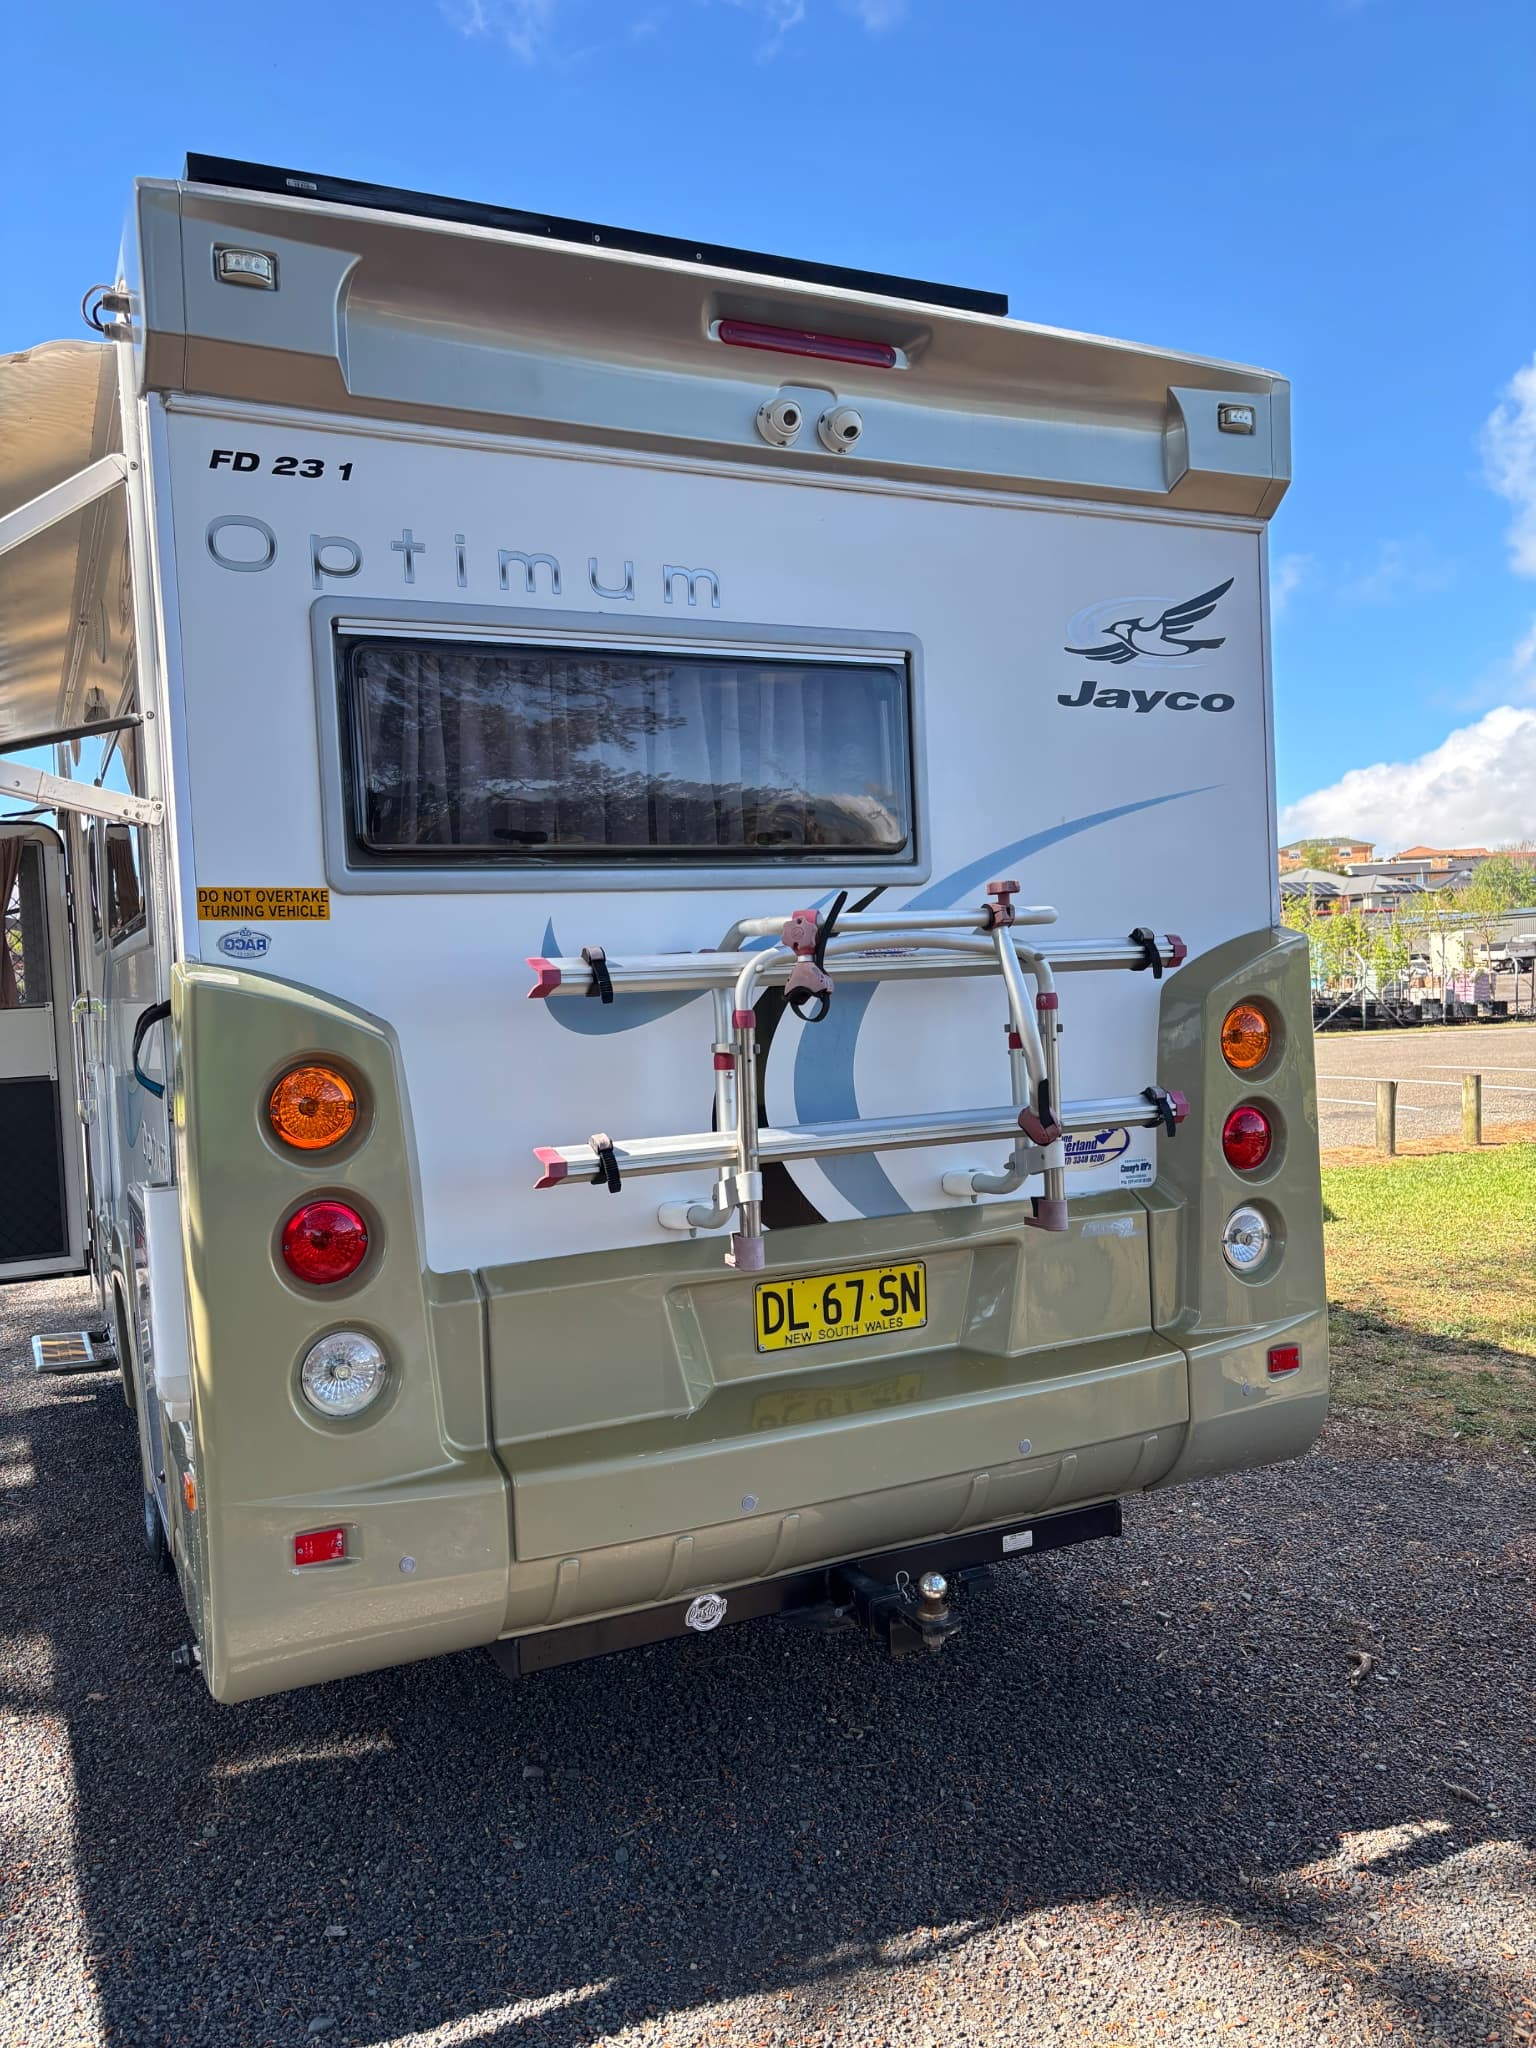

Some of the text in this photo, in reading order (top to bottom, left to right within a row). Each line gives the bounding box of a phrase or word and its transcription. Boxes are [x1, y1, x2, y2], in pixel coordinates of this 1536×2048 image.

[208, 449, 260, 473] FD
[205, 514, 721, 608] Optimum
[1057, 680, 1235, 713] Jayco
[199, 890, 329, 903] DO NOT OVERTAKE
[202, 905, 326, 917] TURNING VEHICLE
[784, 1317, 904, 1345] NEW SOUTH WALES
